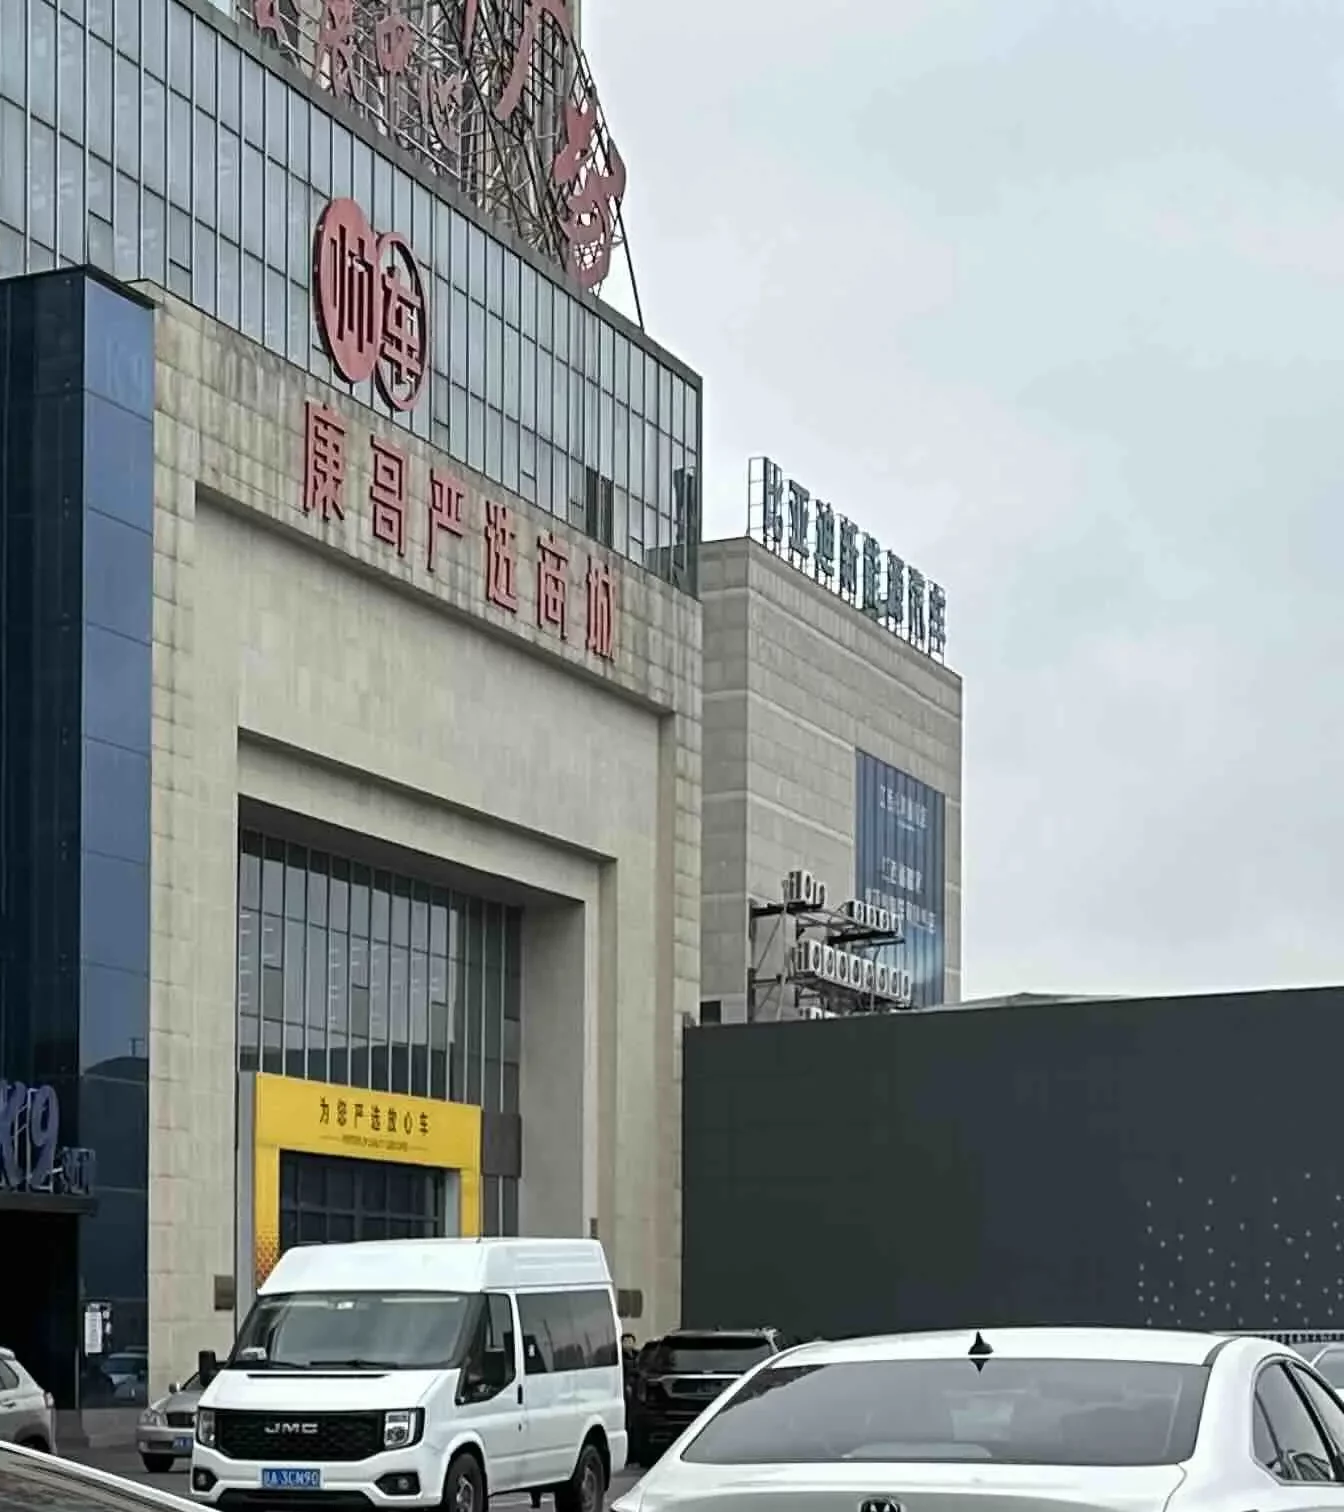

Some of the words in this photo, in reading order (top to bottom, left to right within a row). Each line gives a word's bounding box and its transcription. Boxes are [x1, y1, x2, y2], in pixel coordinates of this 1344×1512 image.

[303, 399, 617, 662] 康哥严选商城
[264, 1422, 319, 1434] JMC
